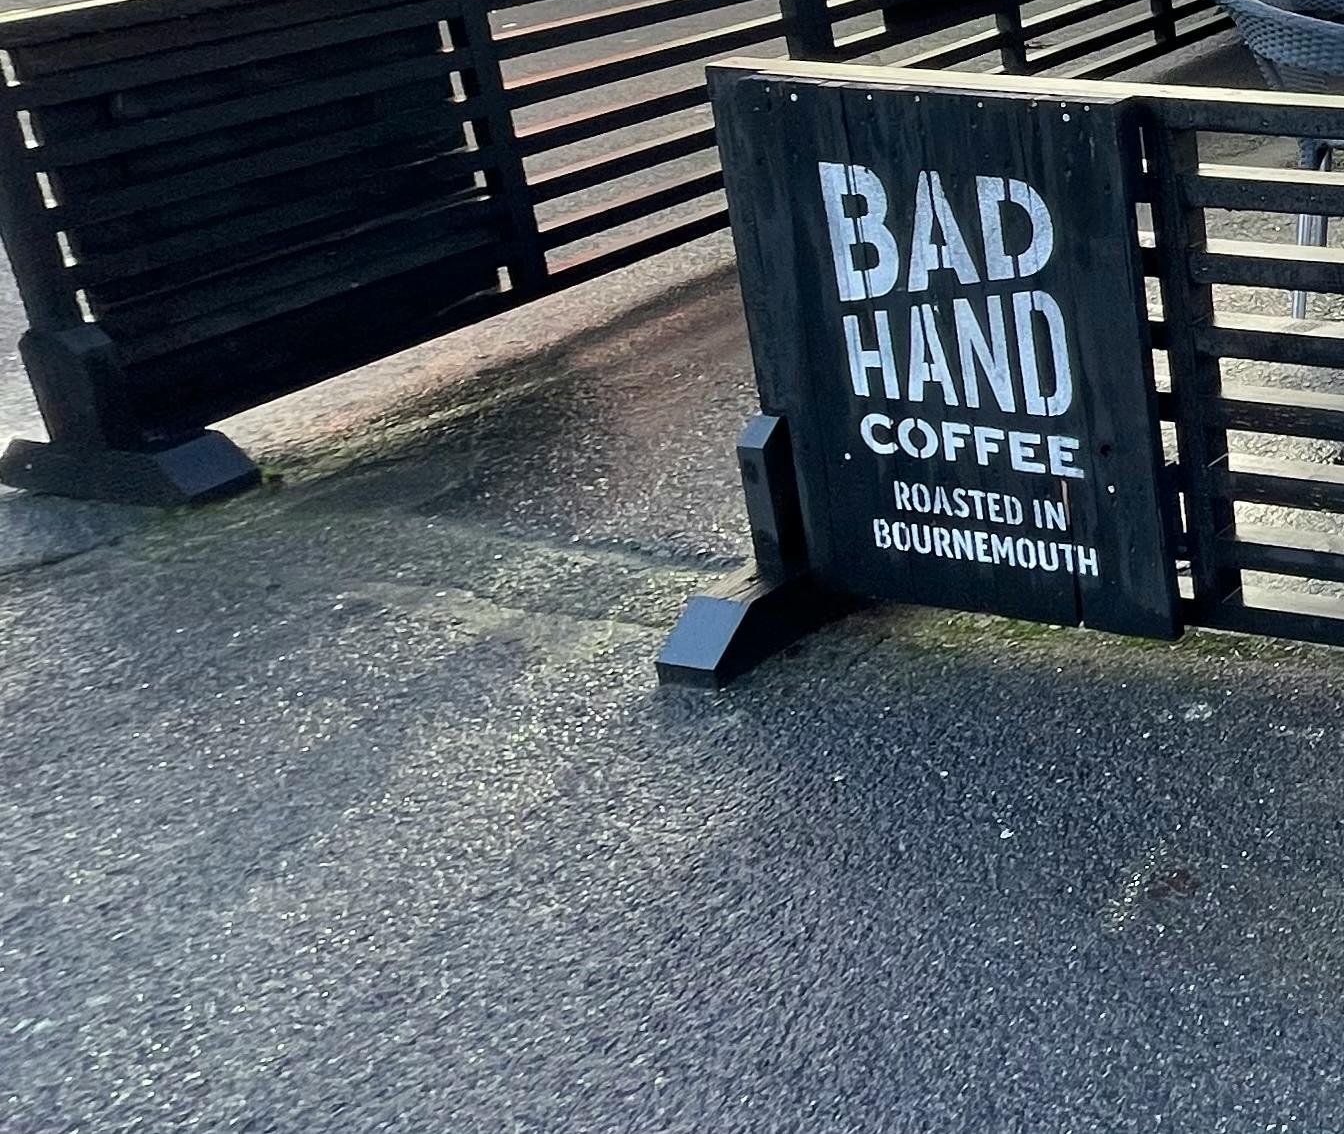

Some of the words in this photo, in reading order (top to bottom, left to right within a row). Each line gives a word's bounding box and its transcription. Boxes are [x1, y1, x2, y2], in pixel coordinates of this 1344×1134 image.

[818, 161, 1055, 302] BAD
[841, 289, 1074, 417] HAND
[859, 412, 1085, 479] COFFEE
[893, 480, 1024, 526] ROASTED
[1033, 498, 1067, 532] IN
[873, 518, 1099, 578] BOURNEMOUTH
